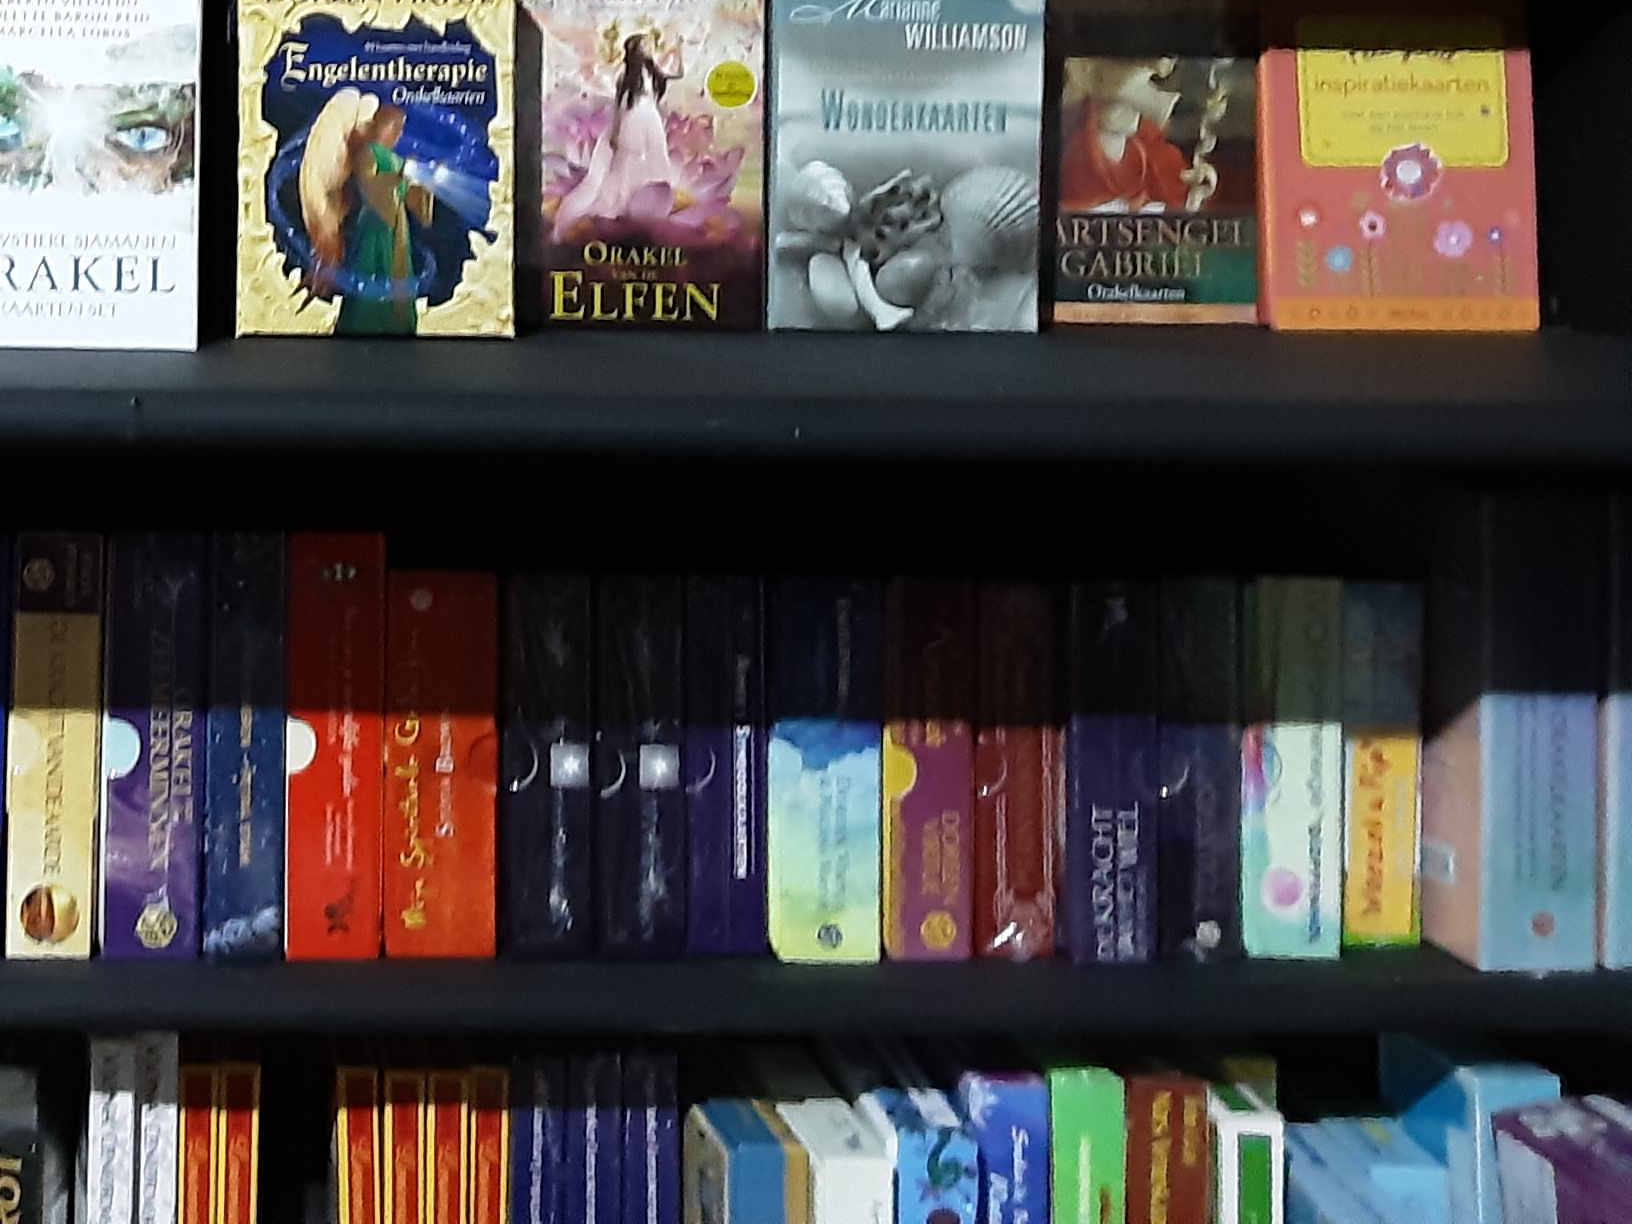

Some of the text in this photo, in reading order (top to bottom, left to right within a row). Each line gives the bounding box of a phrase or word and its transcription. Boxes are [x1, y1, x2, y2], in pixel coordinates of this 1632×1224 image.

[904, 22, 1028, 52] WILLIAMSON
[279, 41, 490, 91] Engelentherapie
[819, 87, 1009, 134] WONDERKAARTEN
[582, 240, 688, 268] ORAKEL
[549, 269, 722, 322] ELFEN
